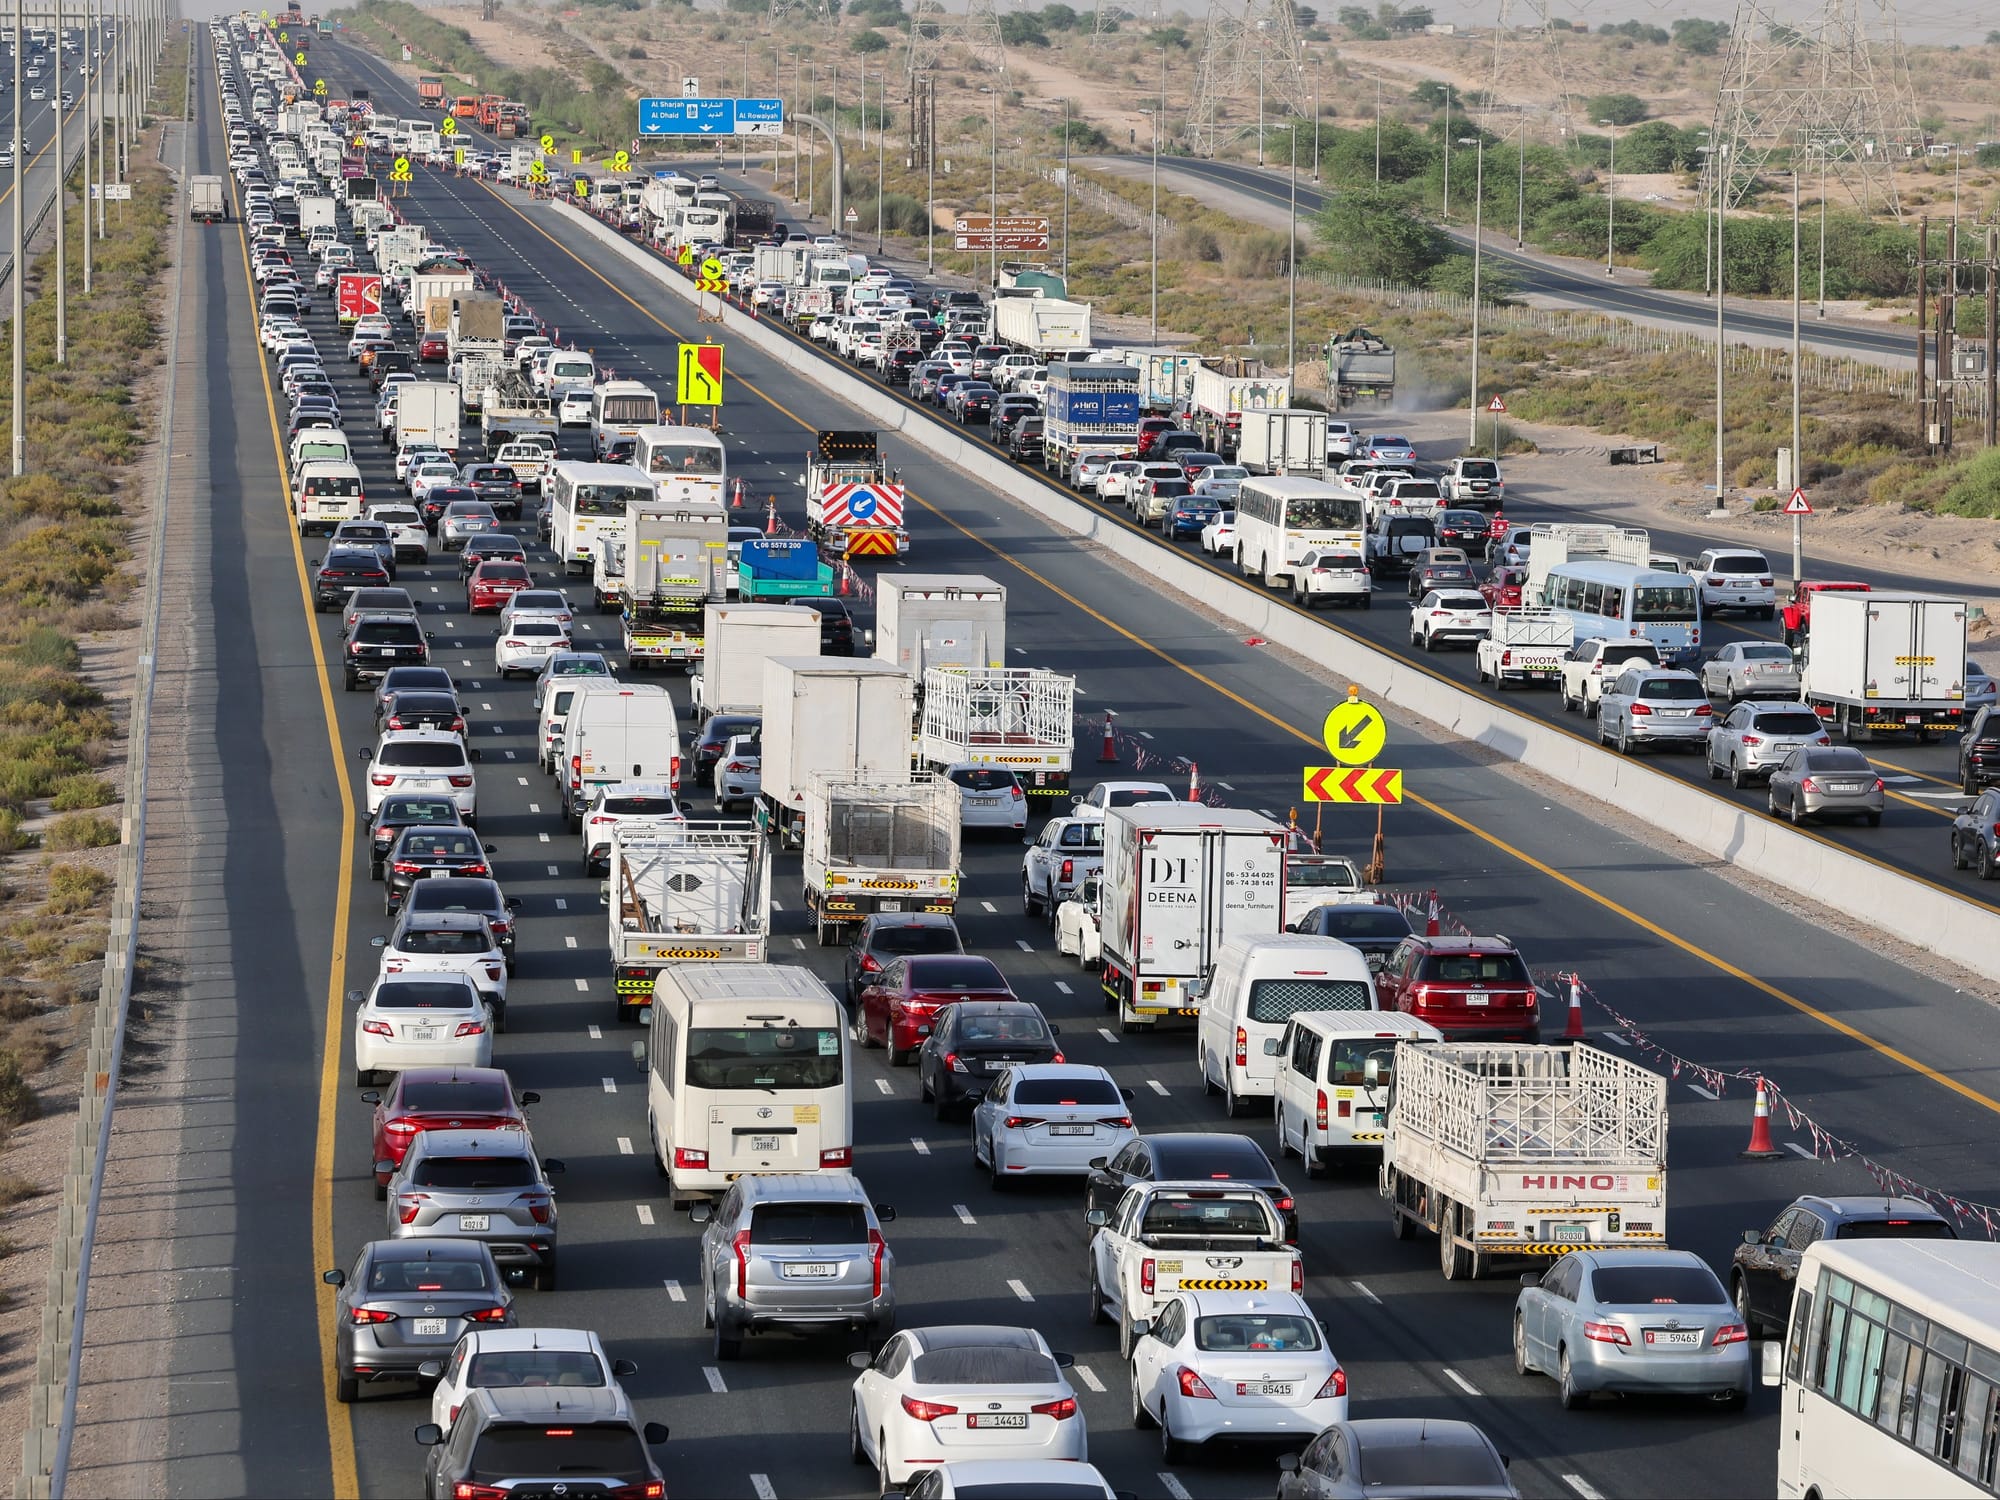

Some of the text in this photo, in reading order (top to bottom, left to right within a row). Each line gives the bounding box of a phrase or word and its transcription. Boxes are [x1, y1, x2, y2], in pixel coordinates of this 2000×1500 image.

[660, 101, 684, 109] Sharjah
[701, 101, 723, 109] الشارقة
[1520, 656, 1558, 664] TOYOTA
[1148, 892, 1197, 903] DEENA
[1522, 1175, 1613, 1190] HINO
[464, 1221, 484, 1229] 40219
[1559, 1232, 1582, 1240] 82030
[806, 1265, 826, 1274] 10473
[420, 1325, 441, 1334] 18308
[1647, 1333, 1698, 1343] 9 59463
[1237, 1384, 1291, 1394] 20 85415
[988, 1402, 1002, 1410] KIA
[970, 1414, 1024, 1426] 9 14413
